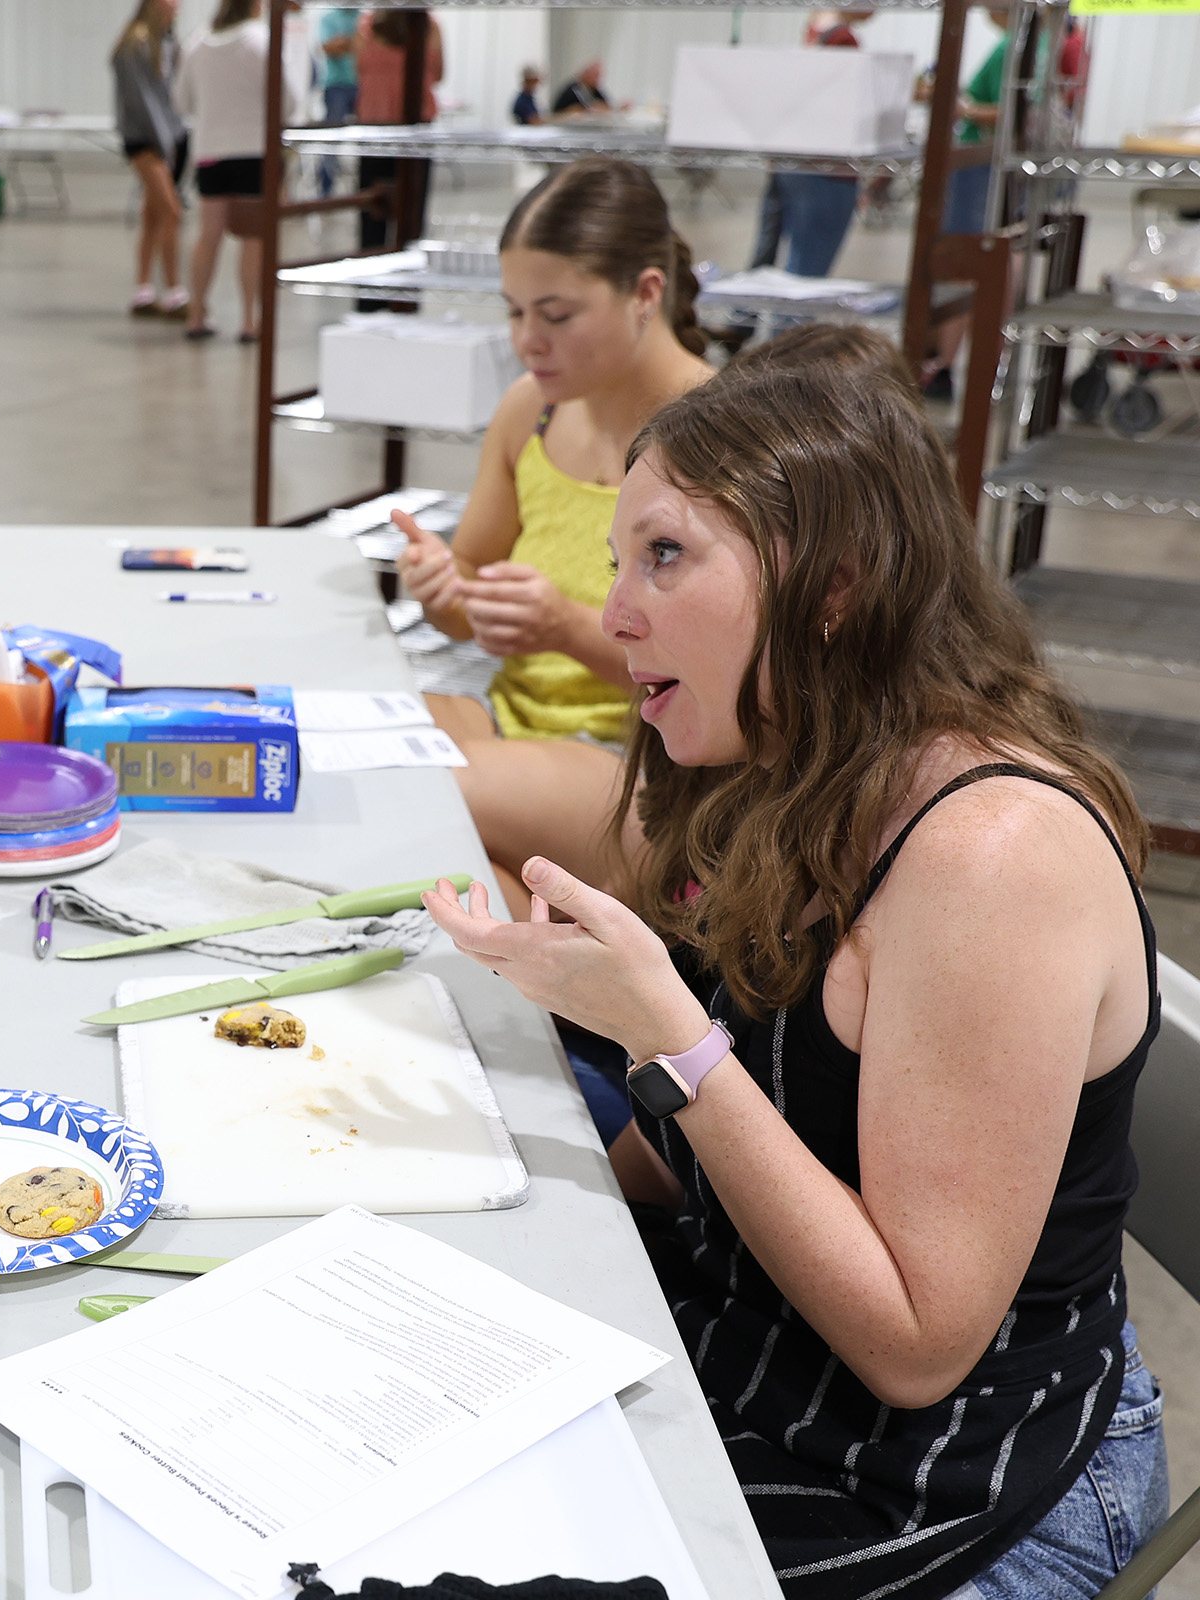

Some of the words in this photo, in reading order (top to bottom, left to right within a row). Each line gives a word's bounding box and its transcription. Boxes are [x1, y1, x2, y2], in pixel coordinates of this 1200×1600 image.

[259, 744, 287, 802] Ziploc
[443, 1393, 480, 1419] Instructions
[118, 1431, 151, 1456] Cookies
[363, 1442, 398, 1467] Ingredients
[150, 1455, 178, 1475] Butter
[175, 1473, 207, 1496] Peanut
[205, 1494, 235, 1516] Pieces
[234, 1514, 269, 1540] Reese's
